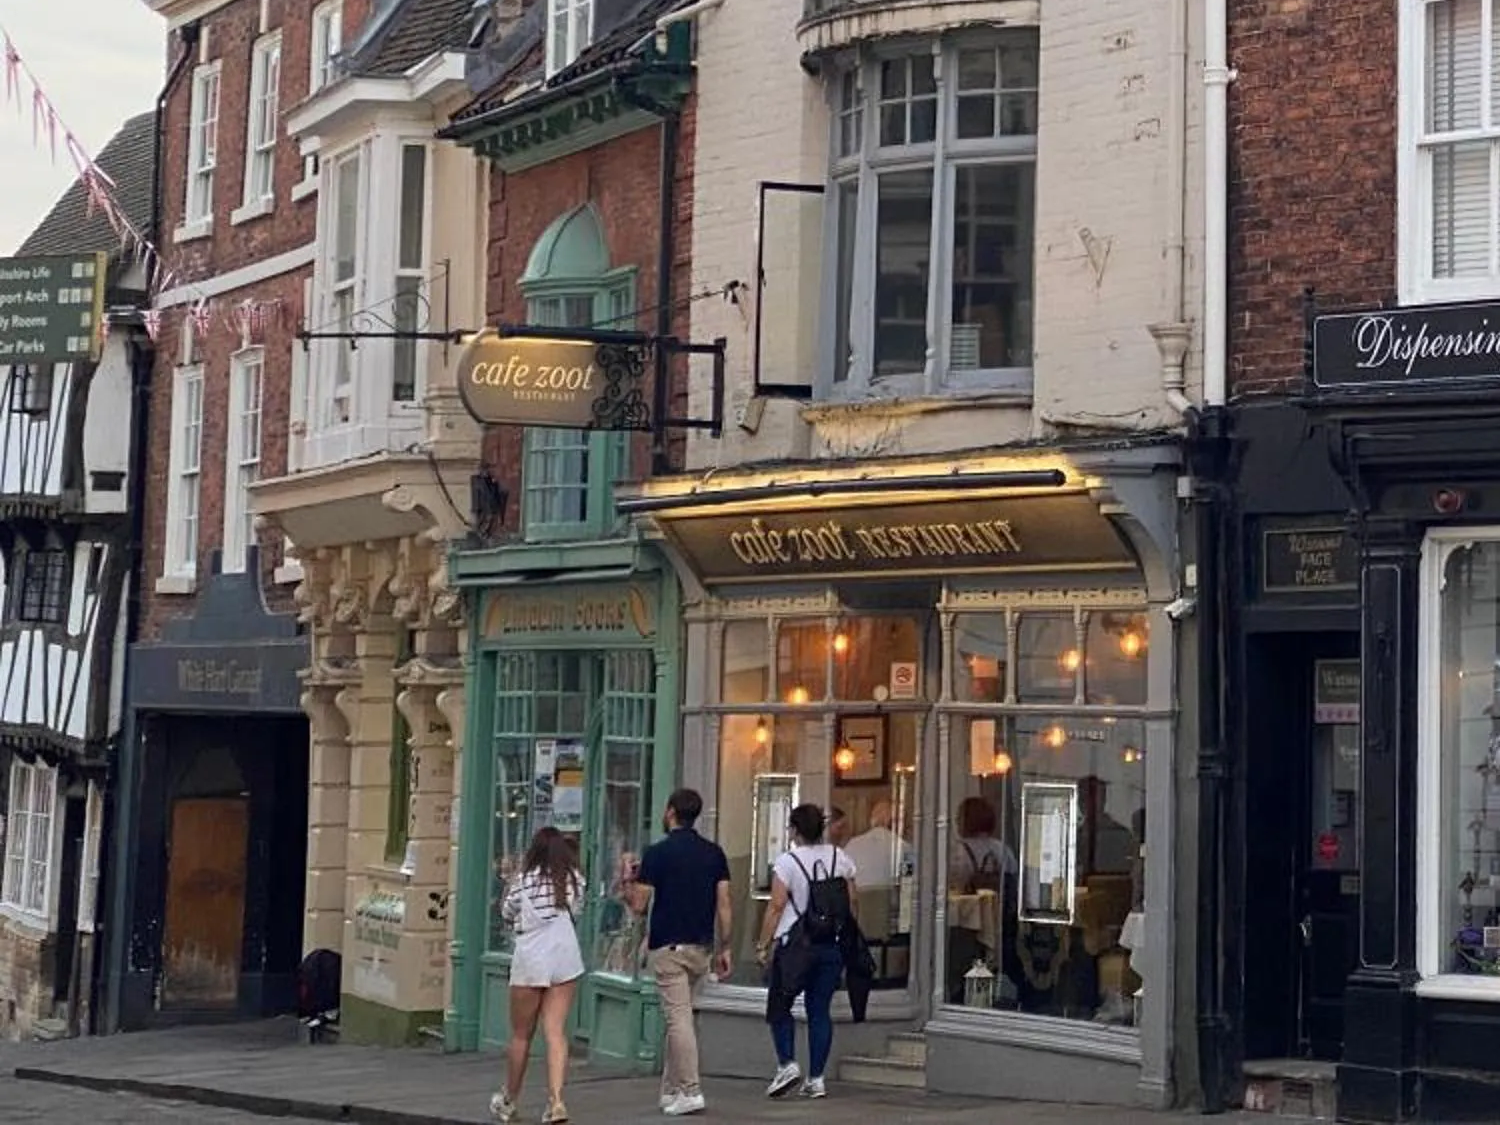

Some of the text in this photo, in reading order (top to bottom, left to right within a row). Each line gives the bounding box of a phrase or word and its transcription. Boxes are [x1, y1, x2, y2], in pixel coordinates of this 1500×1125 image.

[24, 288, 48, 303] Arch
[16, 338, 45, 353] Parks
[471, 355, 596, 391] cafe zoot
[788, 520, 856, 561] zoot
[855, 520, 1021, 558] RESTAURANT
